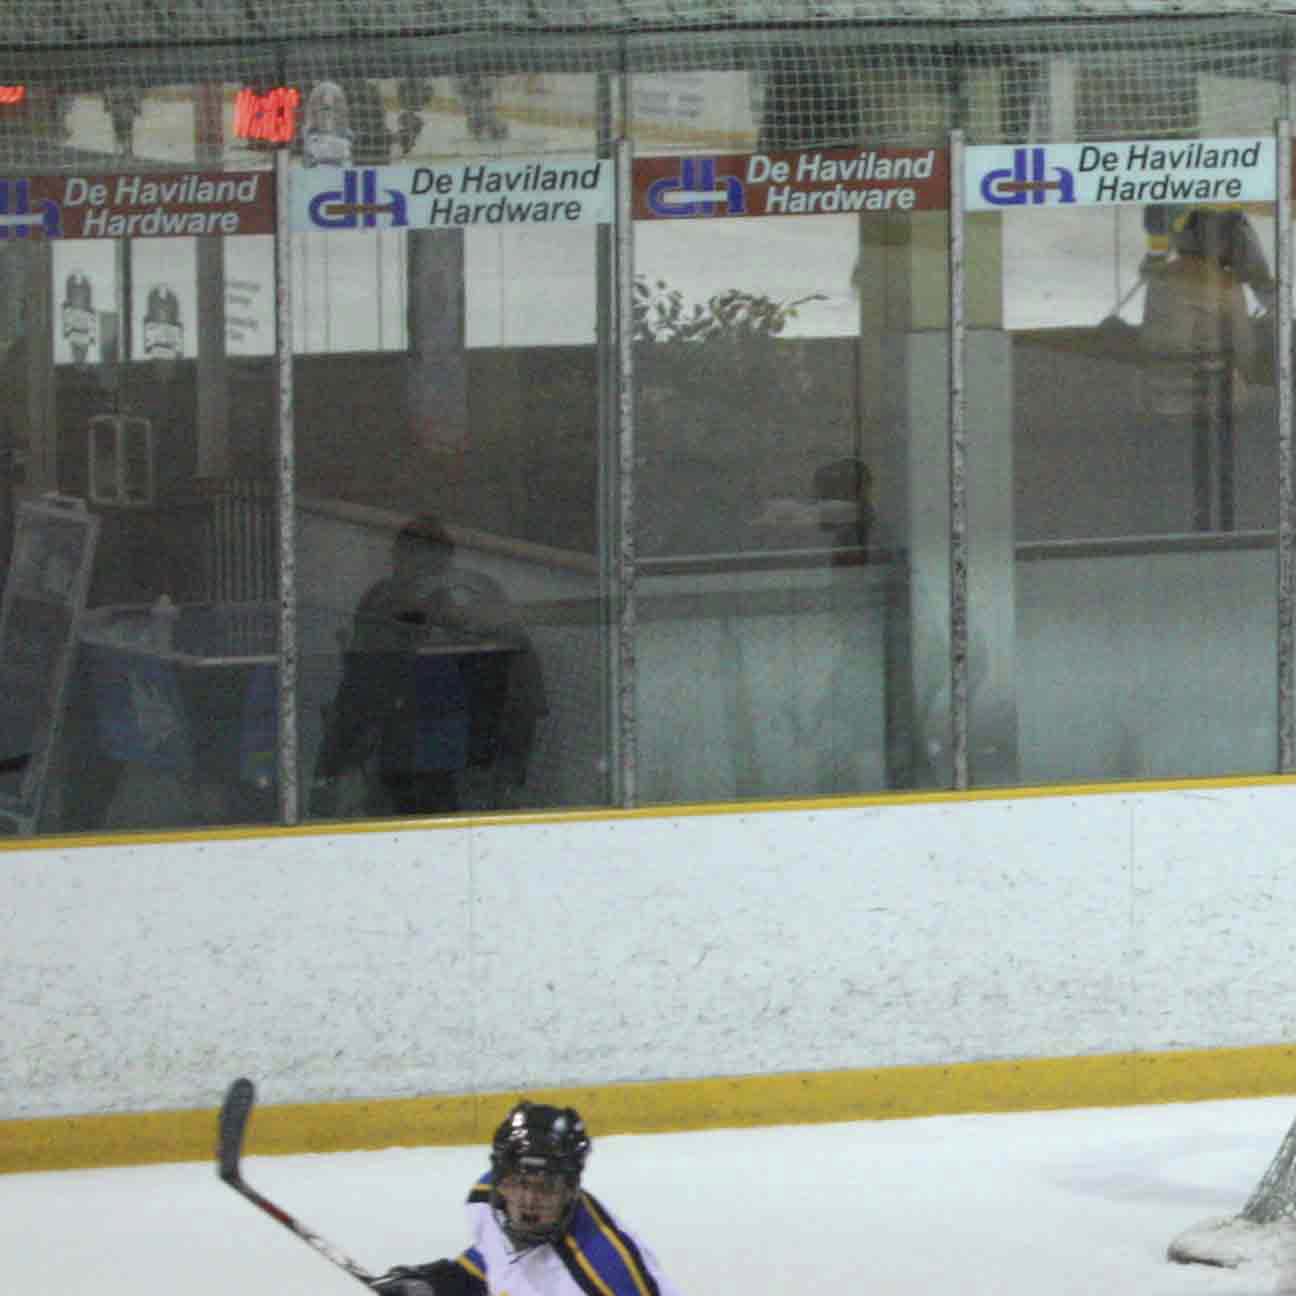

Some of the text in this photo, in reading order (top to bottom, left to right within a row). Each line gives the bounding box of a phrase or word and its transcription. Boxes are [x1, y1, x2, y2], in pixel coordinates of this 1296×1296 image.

[746, 150, 935, 184] De Haviland
[1078, 141, 1262, 172] De Haviland
[64, 175, 259, 207] De Haviland
[411, 162, 601, 195] De Haviland
[1096, 175, 1243, 202] Hardware
[430, 197, 582, 225] Hardware
[765, 185, 917, 213] Hardware
[82, 207, 240, 236] Hardware
